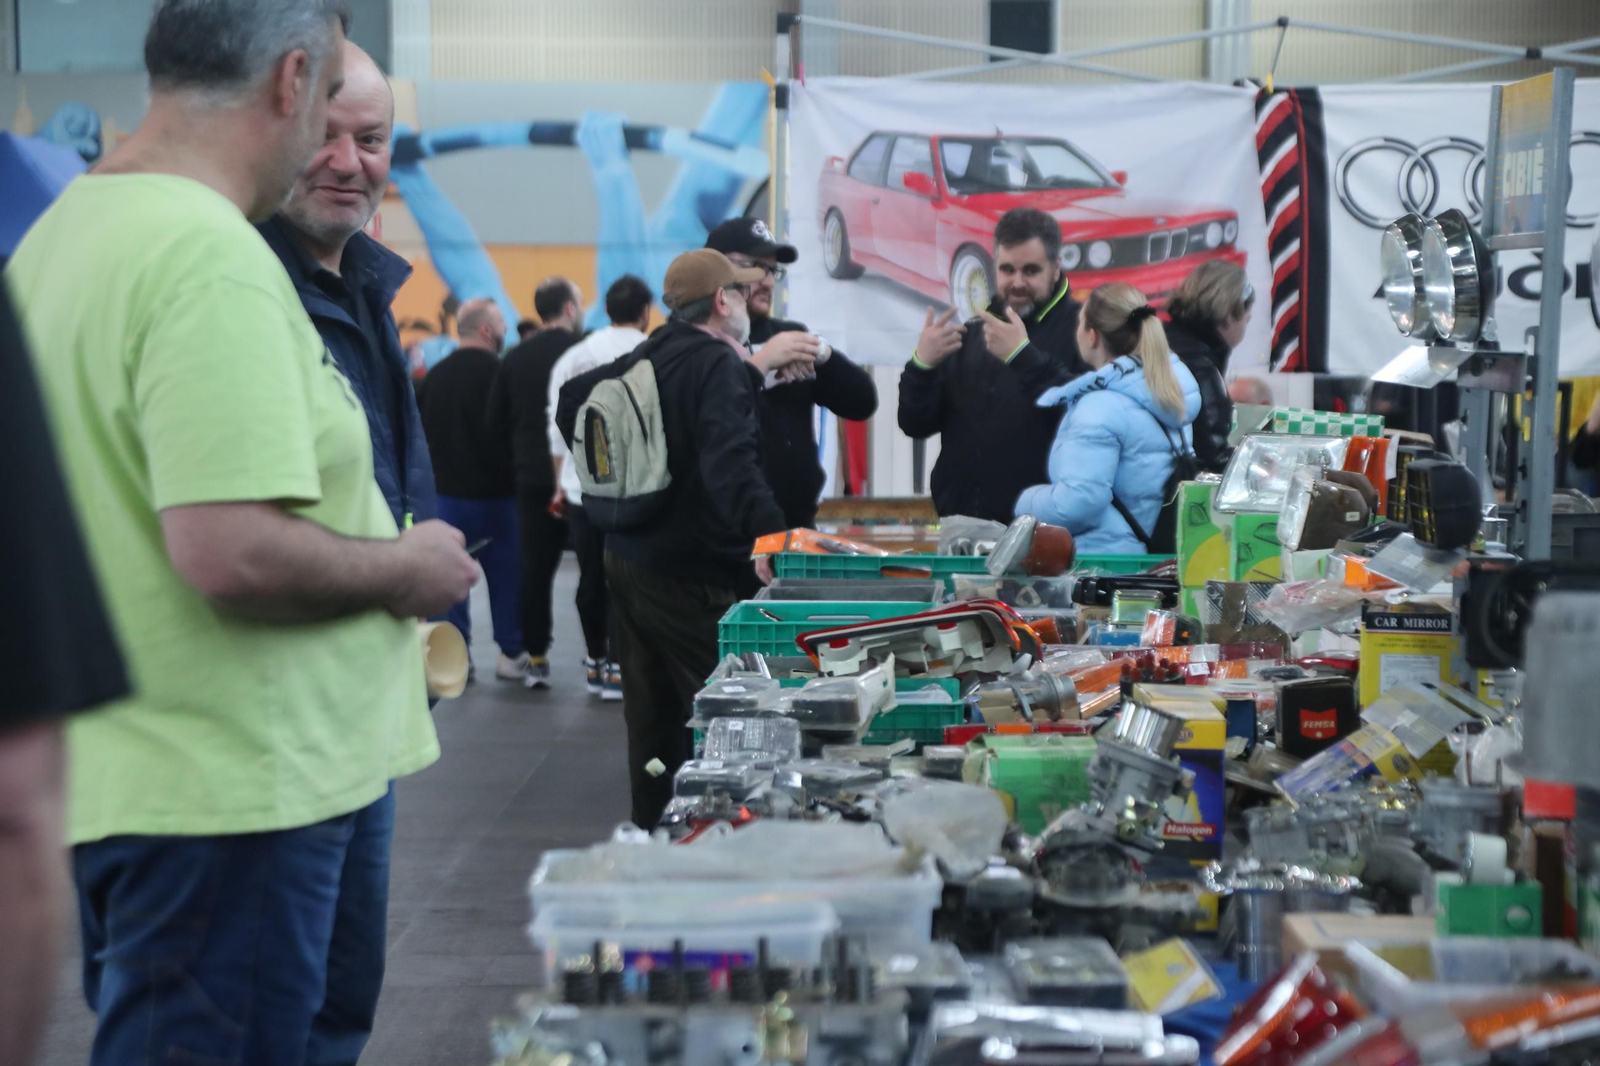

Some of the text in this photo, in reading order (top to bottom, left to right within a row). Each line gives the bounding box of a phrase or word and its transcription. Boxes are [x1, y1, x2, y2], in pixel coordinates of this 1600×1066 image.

[1374, 617, 1448, 629] CAR MIRROR
[1303, 720, 1336, 729] FEMSA
[1167, 823, 1213, 836] Halogen
